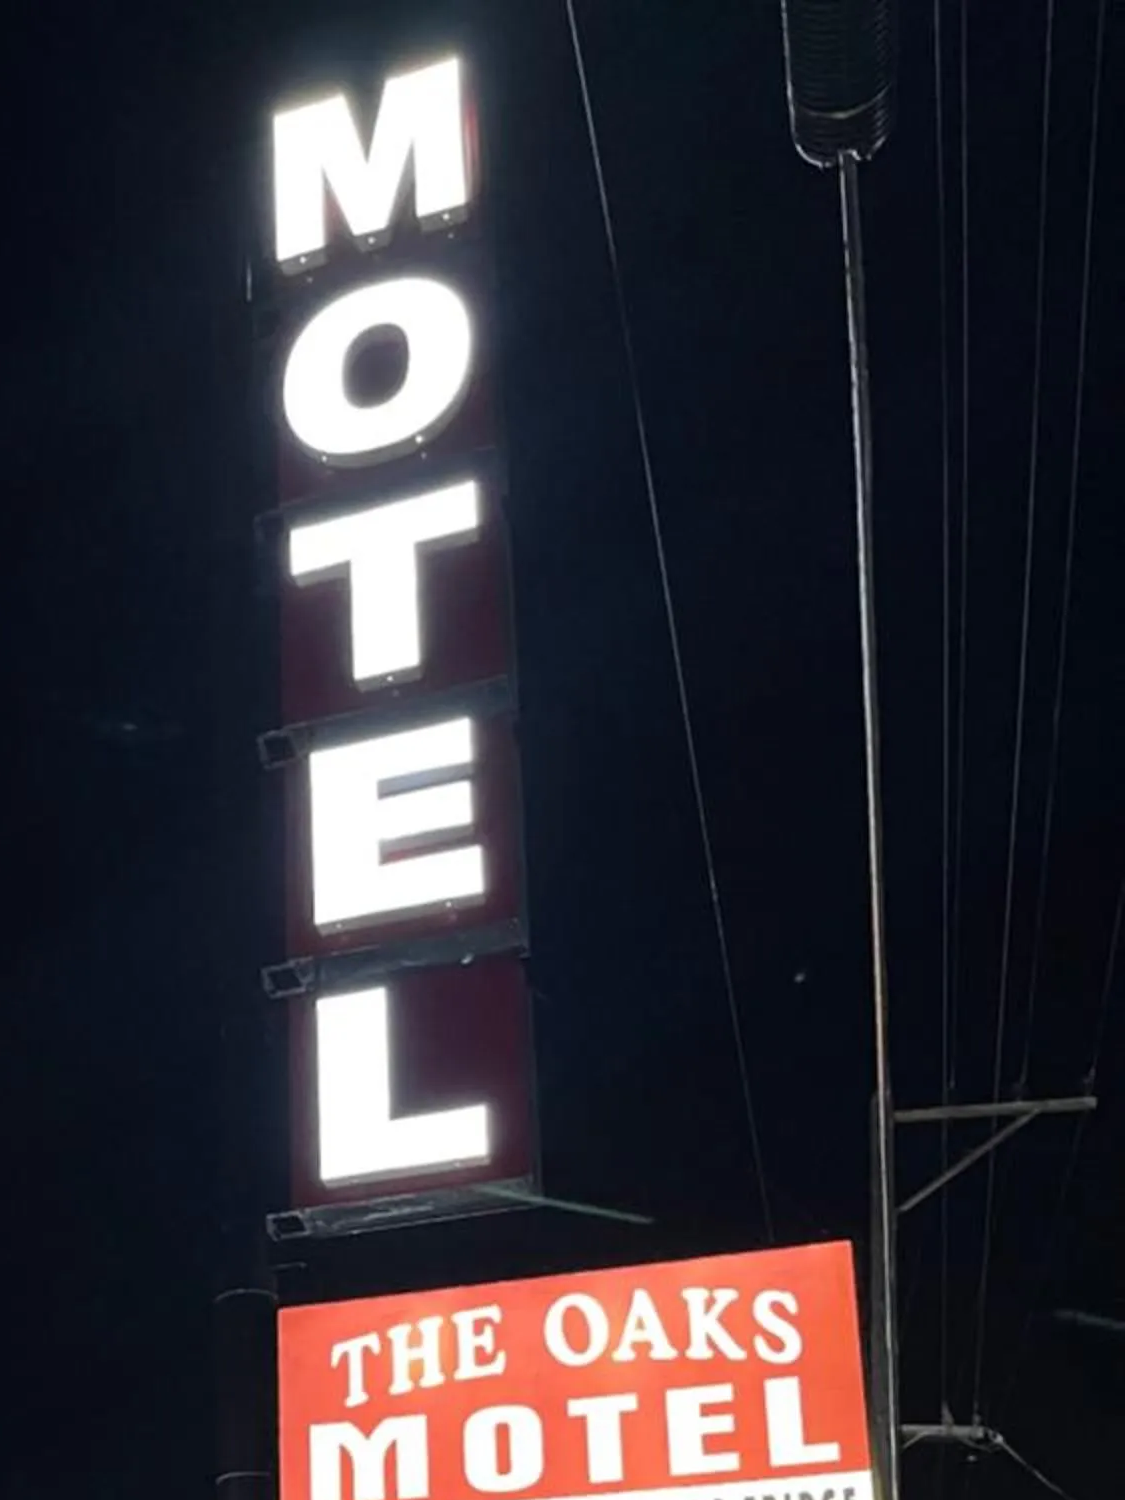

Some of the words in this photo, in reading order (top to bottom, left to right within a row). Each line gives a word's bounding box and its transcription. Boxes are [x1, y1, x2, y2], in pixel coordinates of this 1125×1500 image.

[272, 57, 490, 1183] MOTEL
[330, 1305, 507, 1408] THE
[543, 1286, 803, 1367] OAKS
